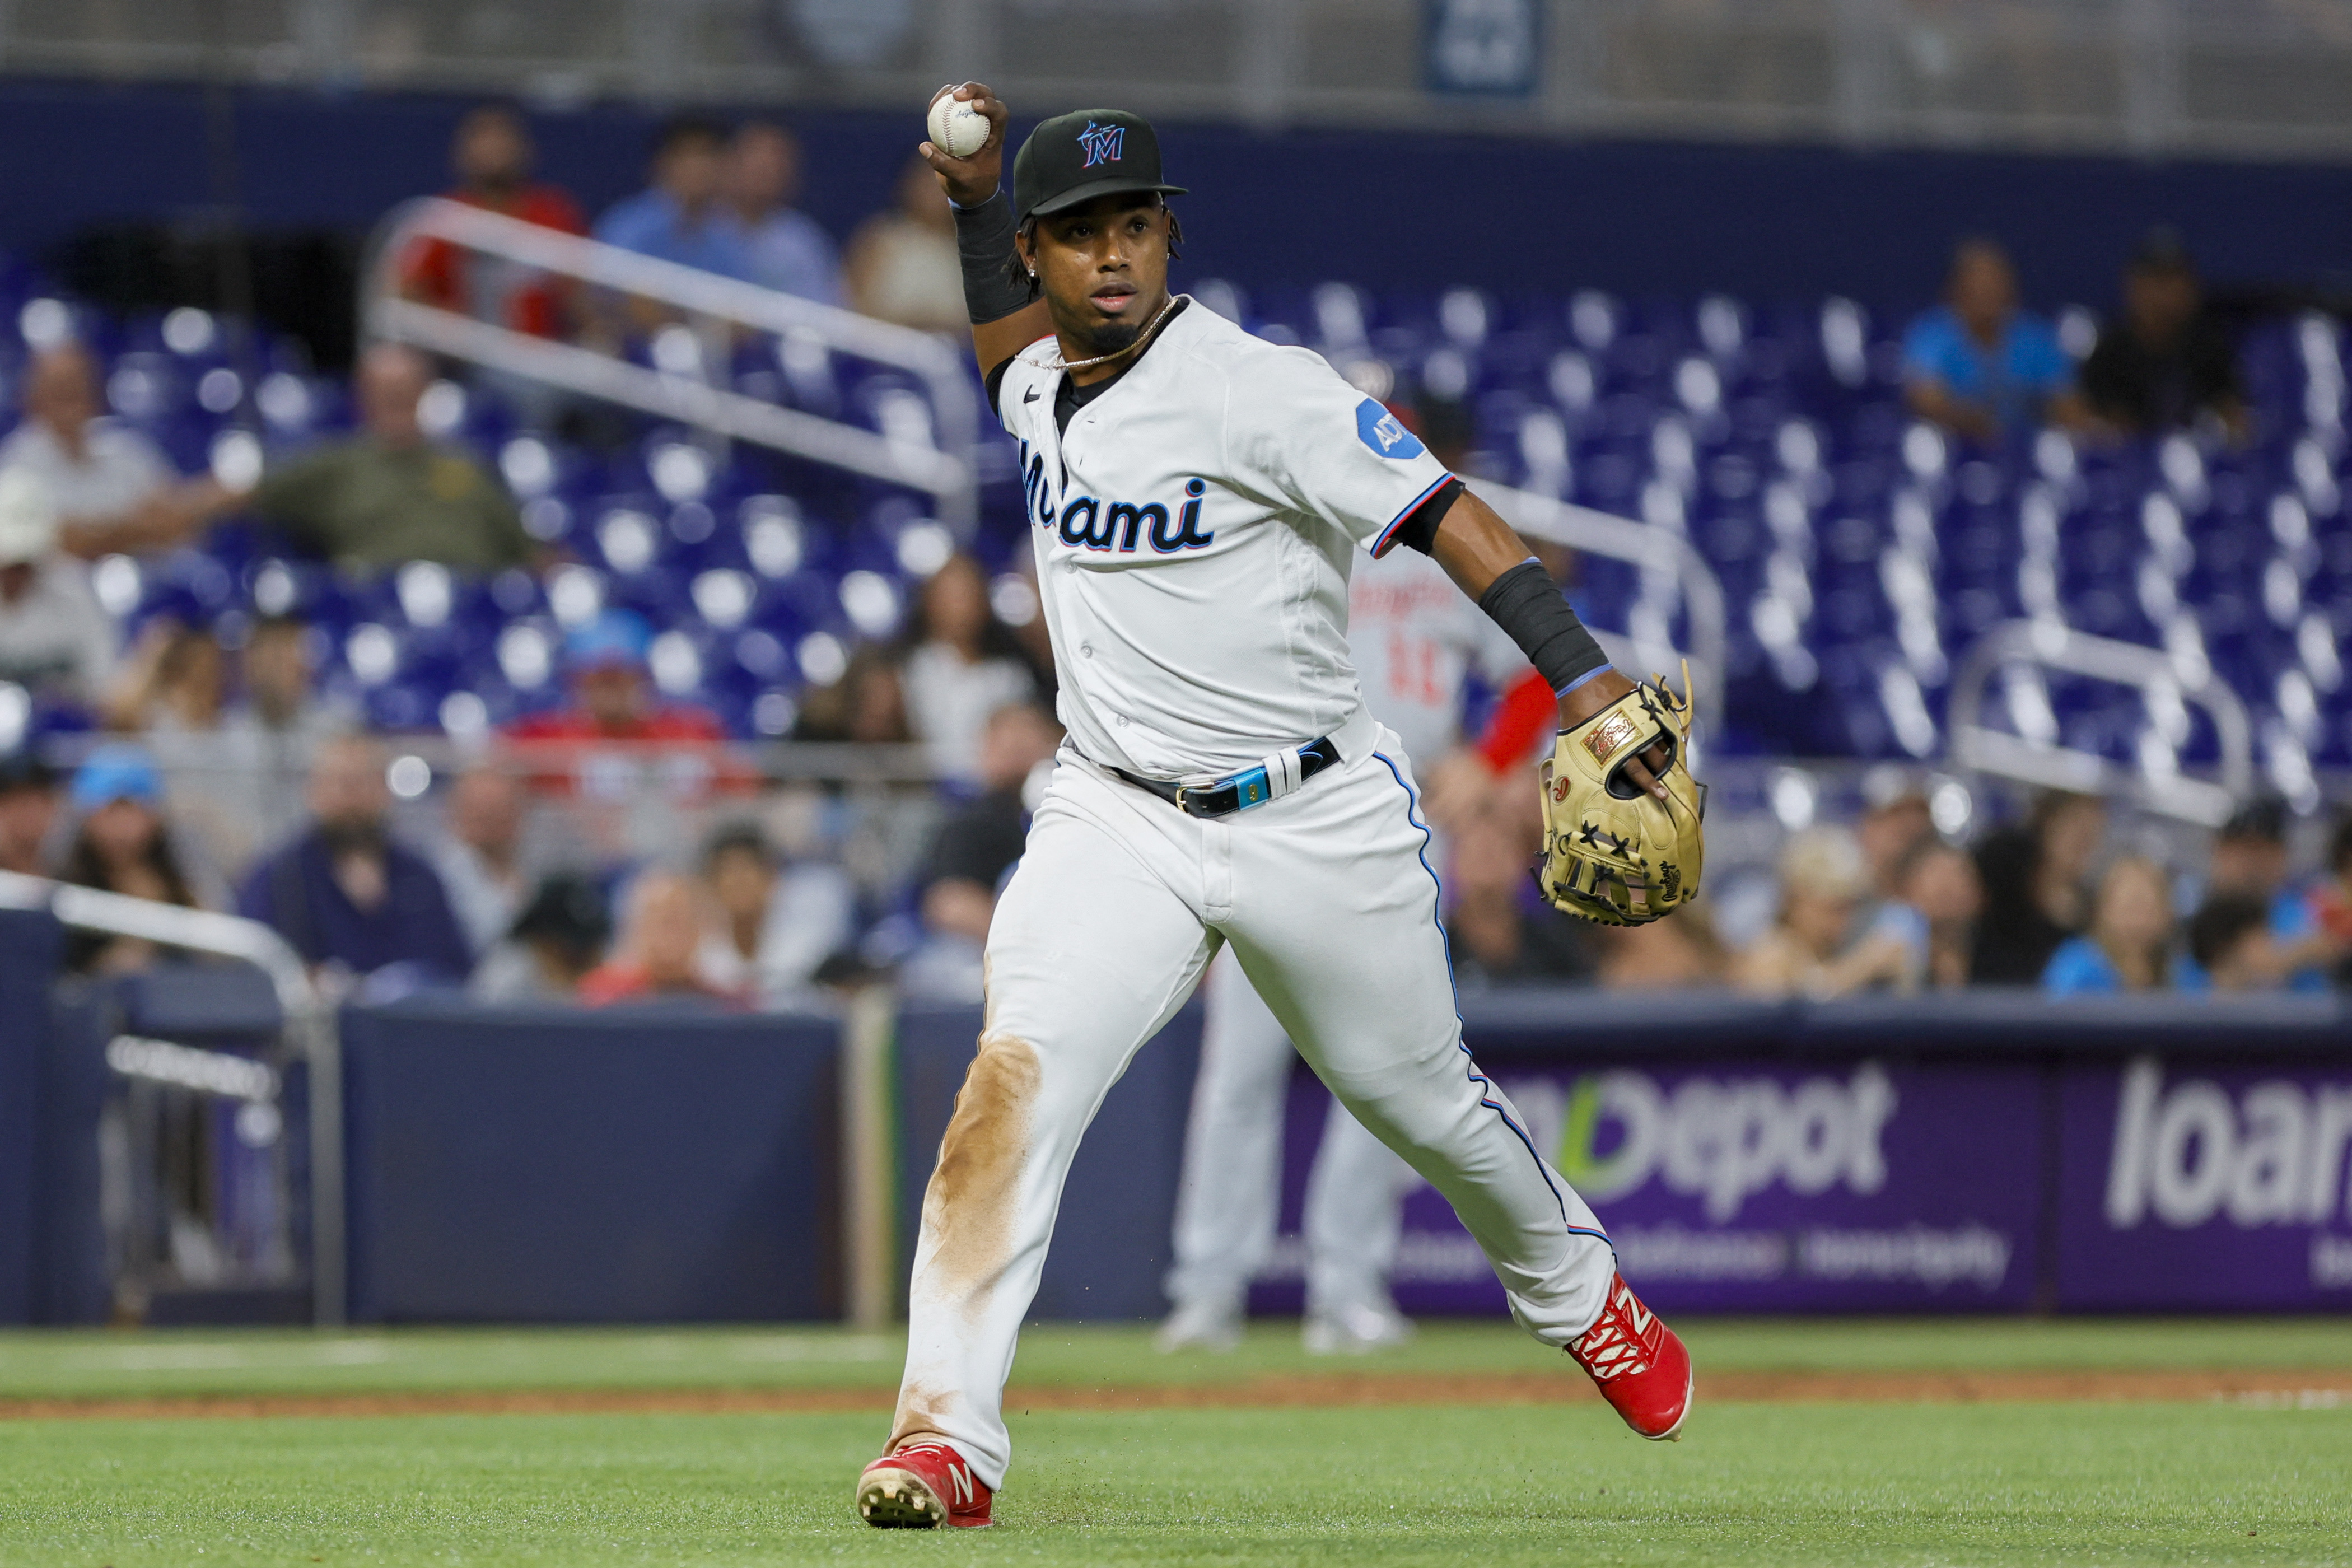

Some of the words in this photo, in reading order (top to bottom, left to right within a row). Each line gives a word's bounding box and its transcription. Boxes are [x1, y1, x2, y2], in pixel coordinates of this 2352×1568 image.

[1373, 413, 1407, 452] ADT
[1248, 783, 1258, 802] 9
[948, 1462, 974, 1505] N
